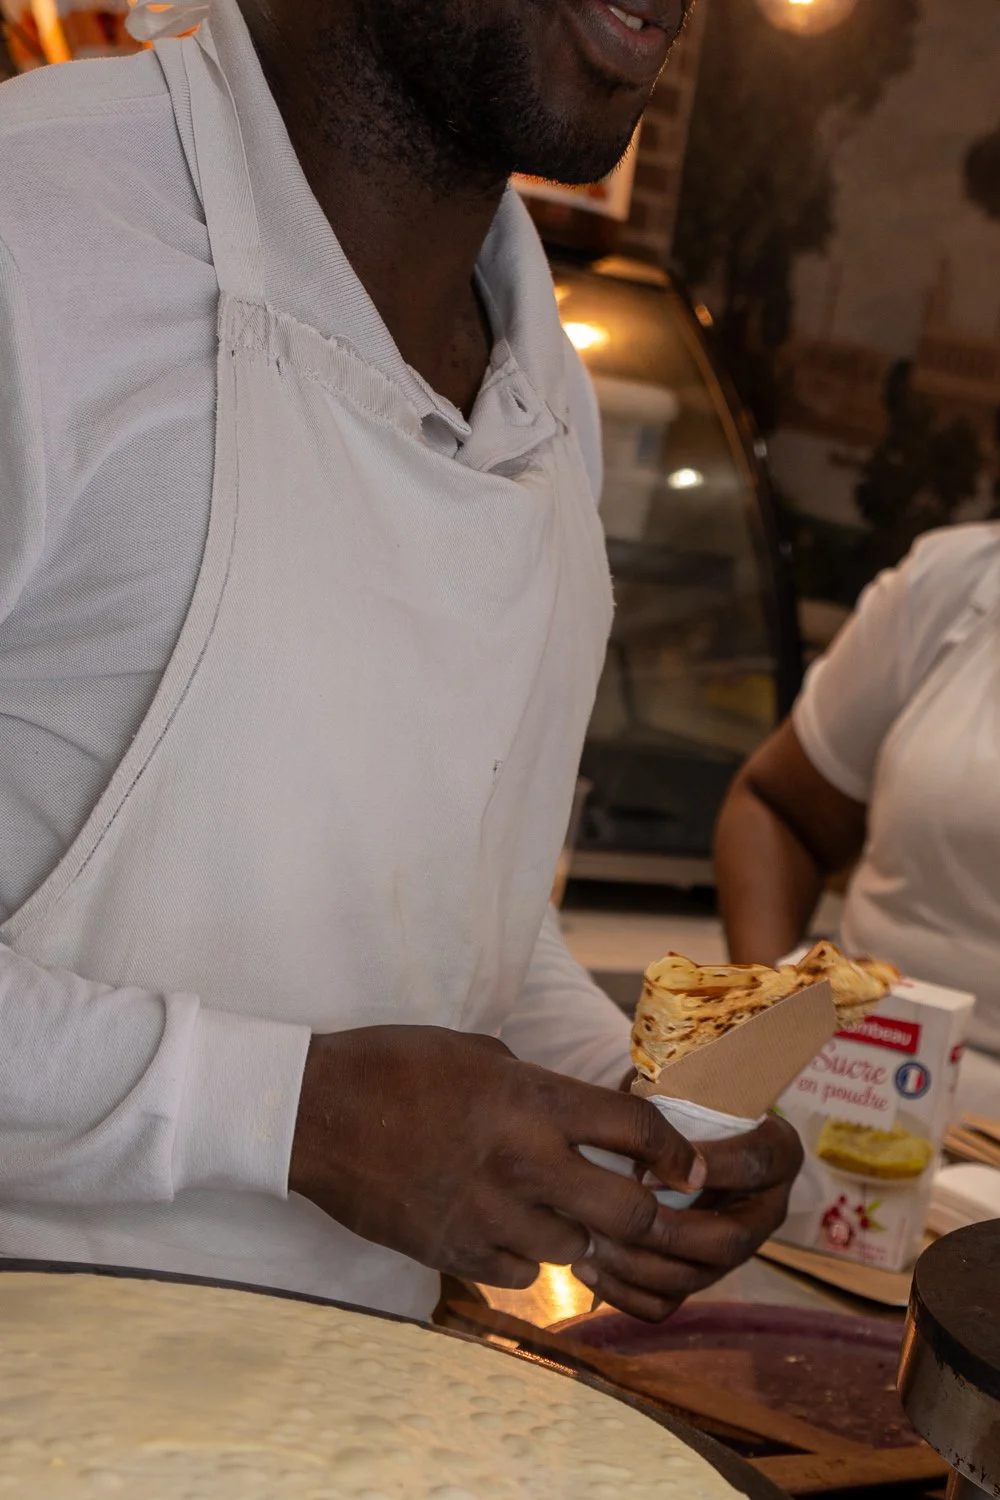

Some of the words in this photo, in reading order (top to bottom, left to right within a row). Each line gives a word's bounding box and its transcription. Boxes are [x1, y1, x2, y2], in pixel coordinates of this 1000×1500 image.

[808, 1040, 888, 1086] Sucre
[797, 1077, 818, 1095] en
[820, 1084, 889, 1112] poudre
